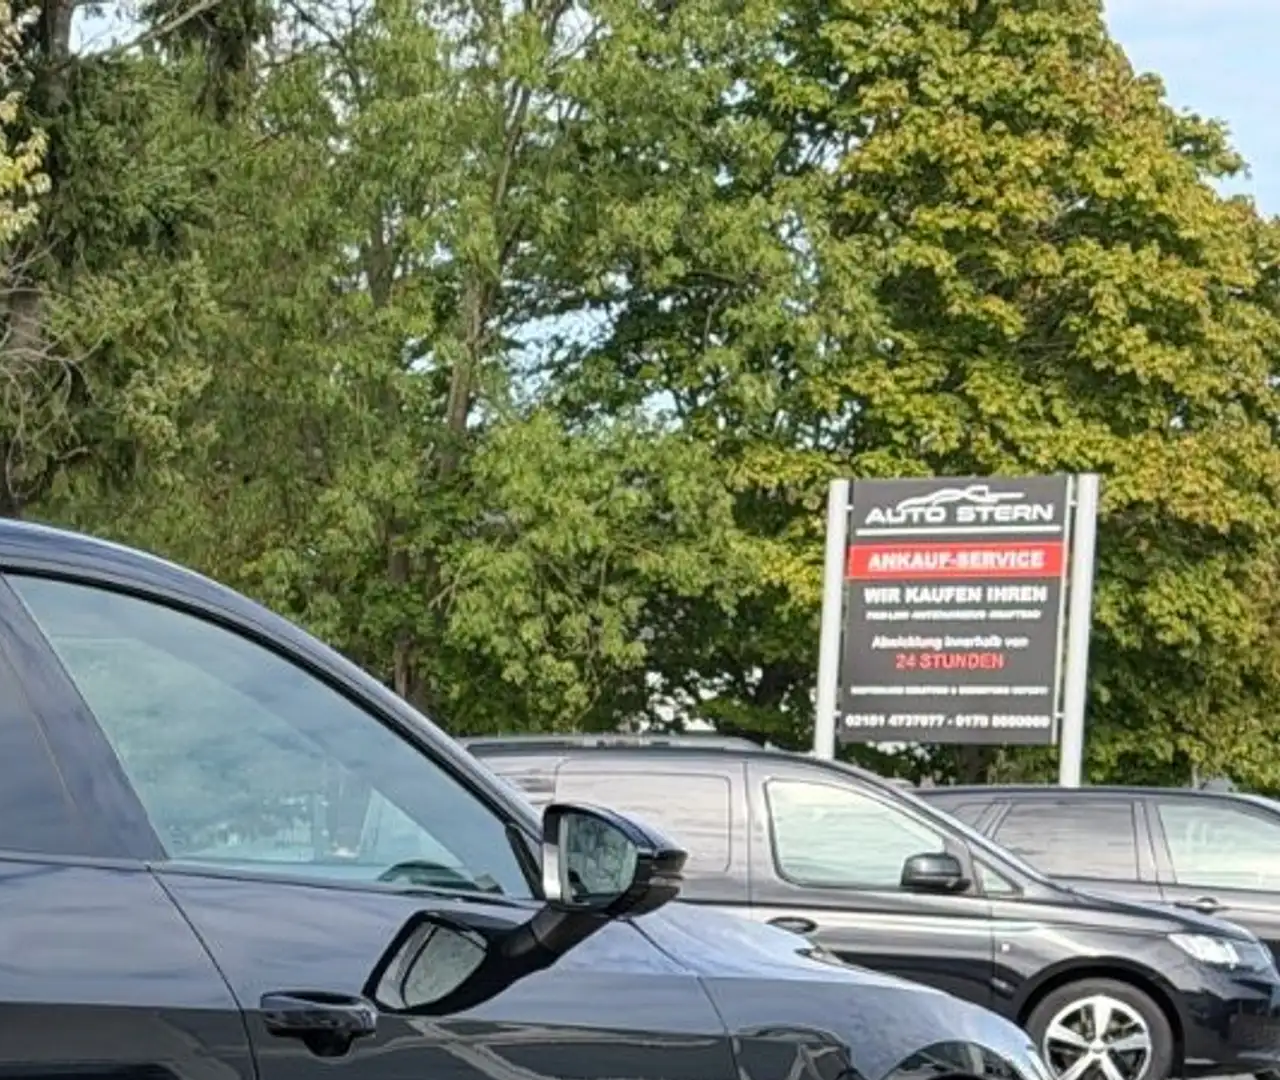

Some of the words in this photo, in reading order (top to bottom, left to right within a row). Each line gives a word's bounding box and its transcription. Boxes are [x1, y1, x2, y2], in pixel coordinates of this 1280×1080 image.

[865, 504, 946, 525] AUTO
[955, 503, 1054, 523] STERN
[867, 549, 1045, 571] ANKAUF-SERVICE
[863, 587, 901, 604] WIR
[986, 585, 1049, 603] IHREN
[895, 654, 916, 669] 24
[919, 652, 1004, 669] STUNDEN
